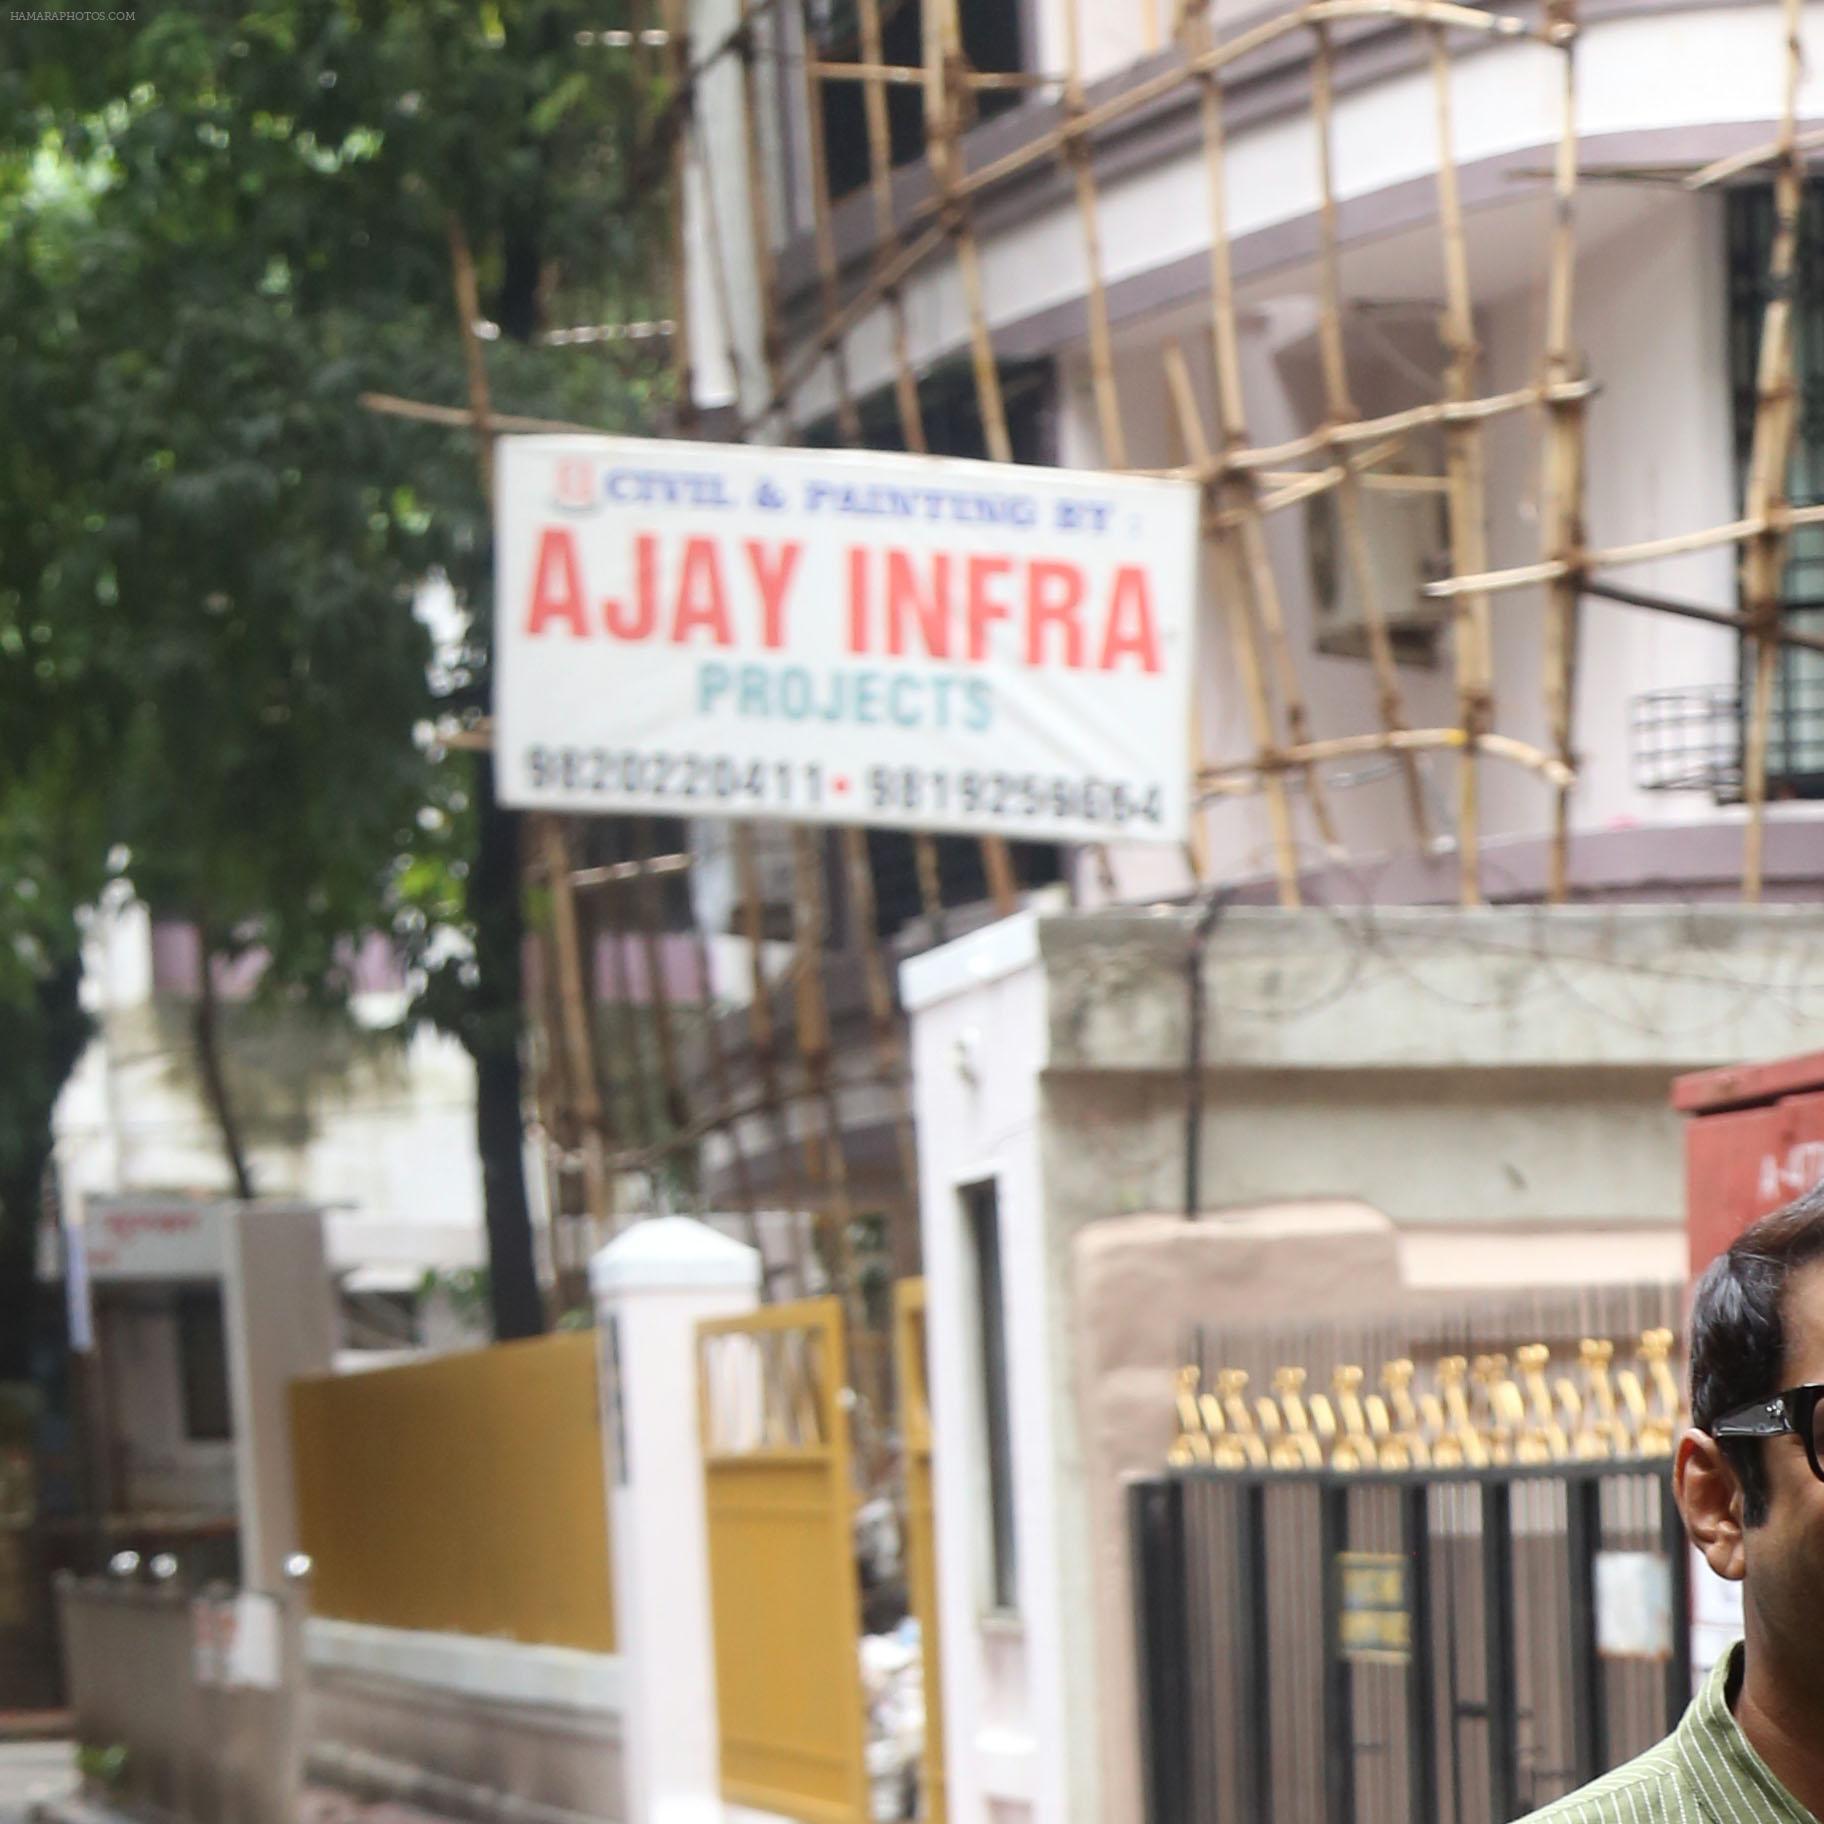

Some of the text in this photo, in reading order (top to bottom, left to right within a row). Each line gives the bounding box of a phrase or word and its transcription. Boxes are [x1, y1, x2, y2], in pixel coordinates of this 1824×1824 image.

[605, 468, 1114, 533] CIVIL & PAINTING BY
[524, 526, 1164, 675] AJAY INFRA
[698, 661, 995, 733] PROJECTS
